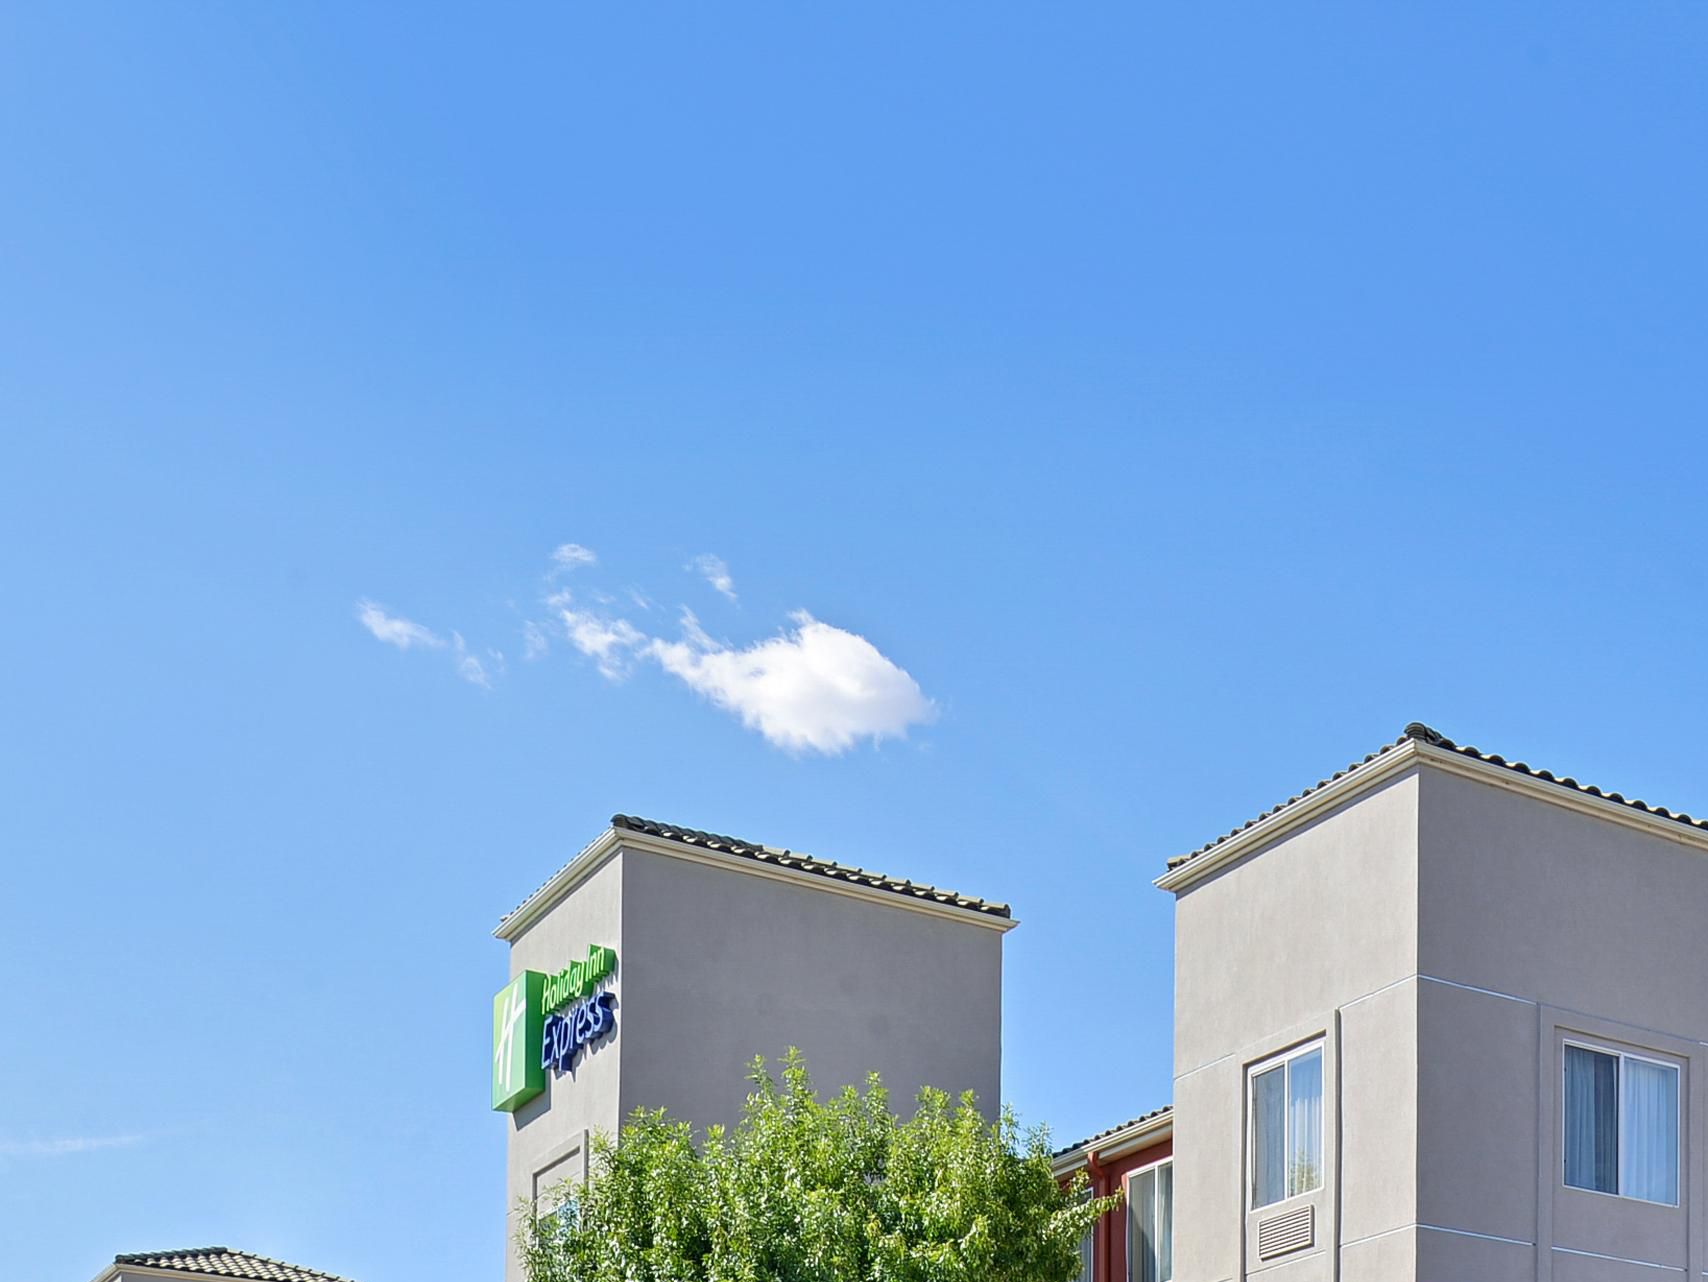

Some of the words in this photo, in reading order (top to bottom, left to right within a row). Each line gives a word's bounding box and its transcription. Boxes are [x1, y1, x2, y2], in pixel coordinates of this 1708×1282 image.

[541, 959, 584, 1015] Holiday
[585, 943, 605, 982] Inn
[541, 991, 607, 1072] Express
